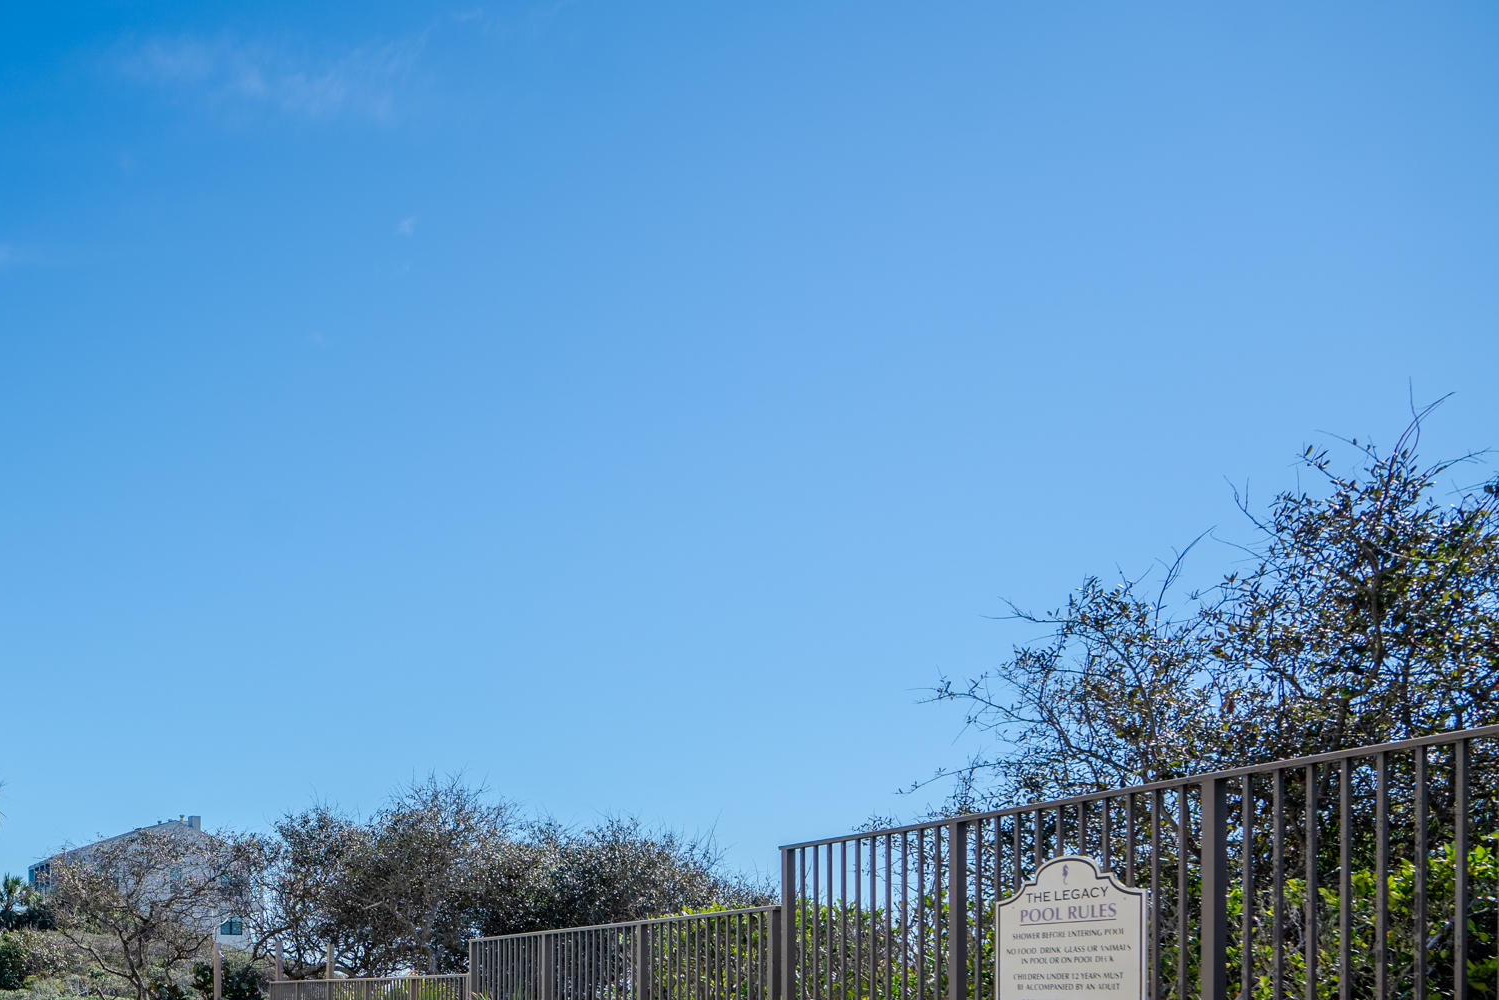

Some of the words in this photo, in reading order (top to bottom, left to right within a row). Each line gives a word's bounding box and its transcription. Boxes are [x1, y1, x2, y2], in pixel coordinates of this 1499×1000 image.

[1026, 892, 1051, 903] THE
[1054, 886, 1109, 901] LEGACY
[1020, 908, 1063, 922] POOL
[1068, 902, 1117, 920] RULES
[1012, 931, 1040, 940] SHOWER
[1042, 930, 1066, 939] BEFORE
[1068, 929, 1102, 938] ENTERING
[1104, 927, 1124, 936] POOL
[1064, 945, 1085, 953] GLASS
[1087, 944, 1098, 952] OR
[1021, 957, 1029, 965] IN
[1030, 957, 1048, 965] POOL
[1061, 956, 1072, 964] ON
[1013, 973, 1045, 981] CHILDREN
[1080, 972, 1101, 980] YEARS
[1103, 971, 1124, 980] MUST
[1026, 983, 1074, 991] ACCOMPANIED
